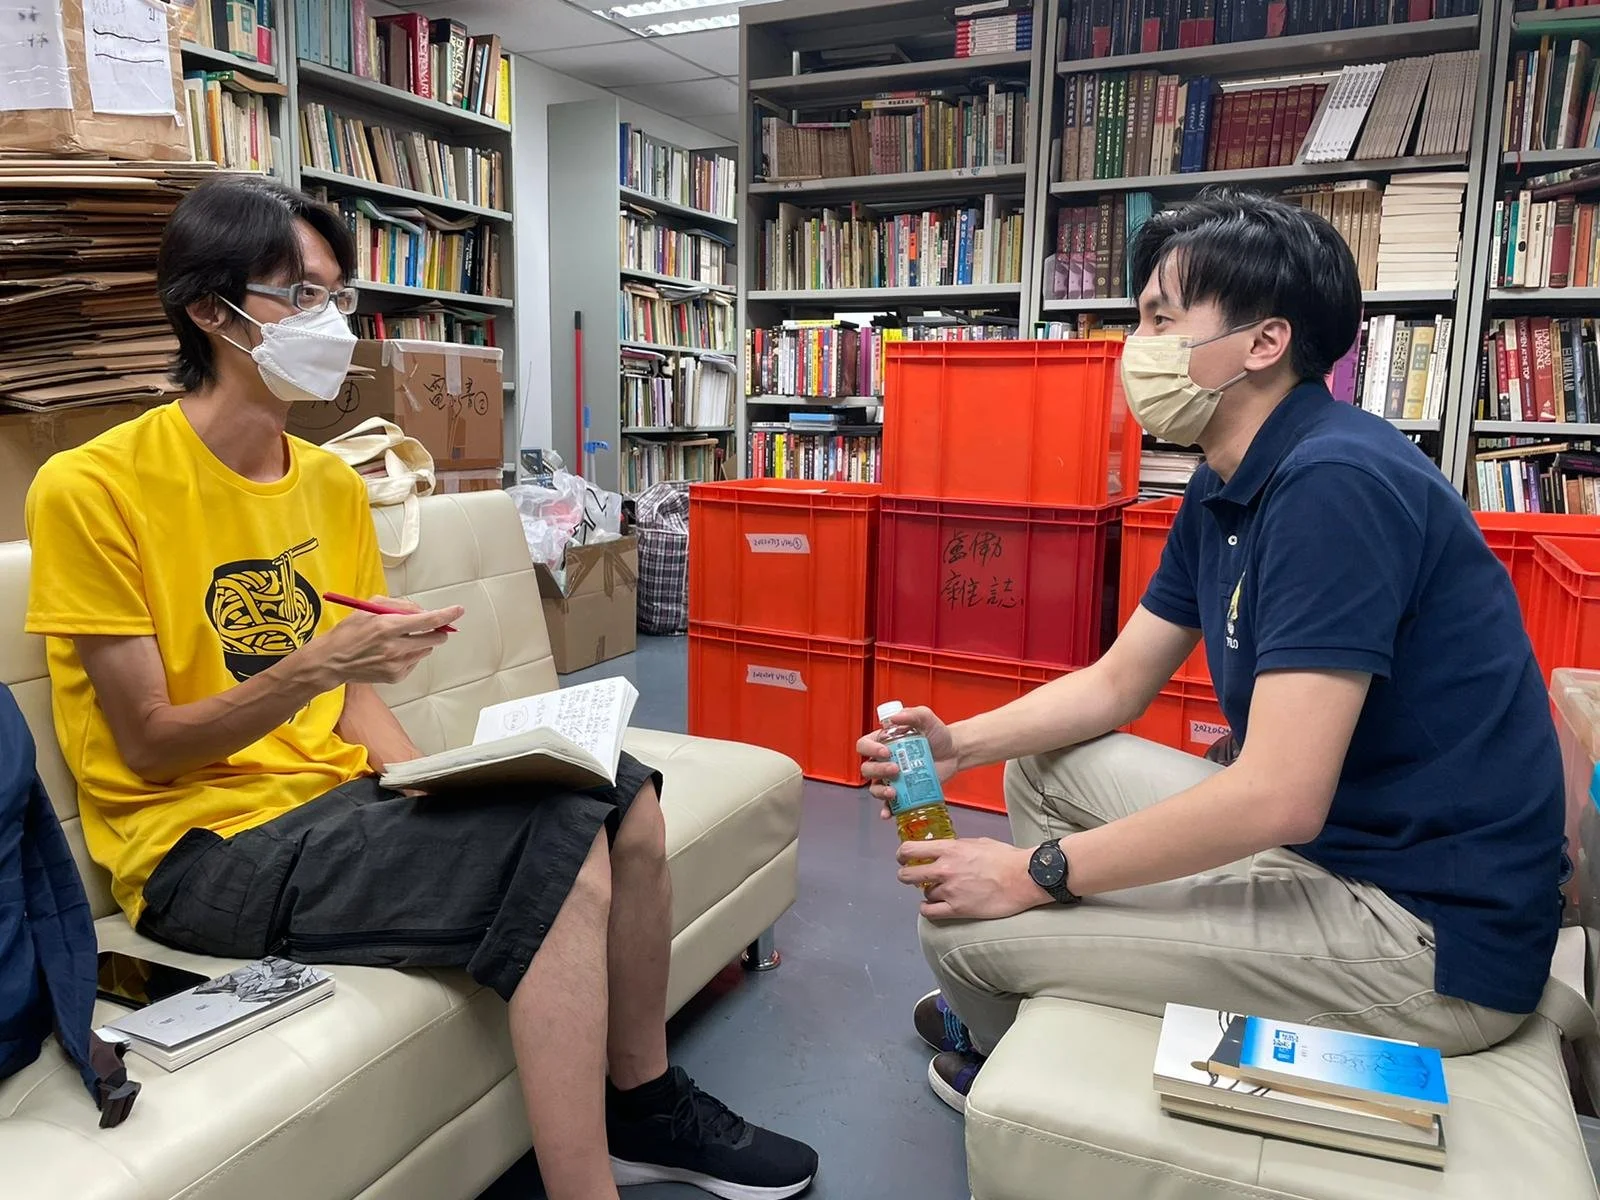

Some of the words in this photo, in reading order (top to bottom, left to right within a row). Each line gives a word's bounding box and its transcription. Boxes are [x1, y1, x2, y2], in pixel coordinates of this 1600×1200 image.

[454, 37, 465, 89] ENGLISH
[1519, 320, 1528, 348] WOMEN
[1522, 366, 1530, 380] TOP
[1564, 379, 1575, 392] LAB
